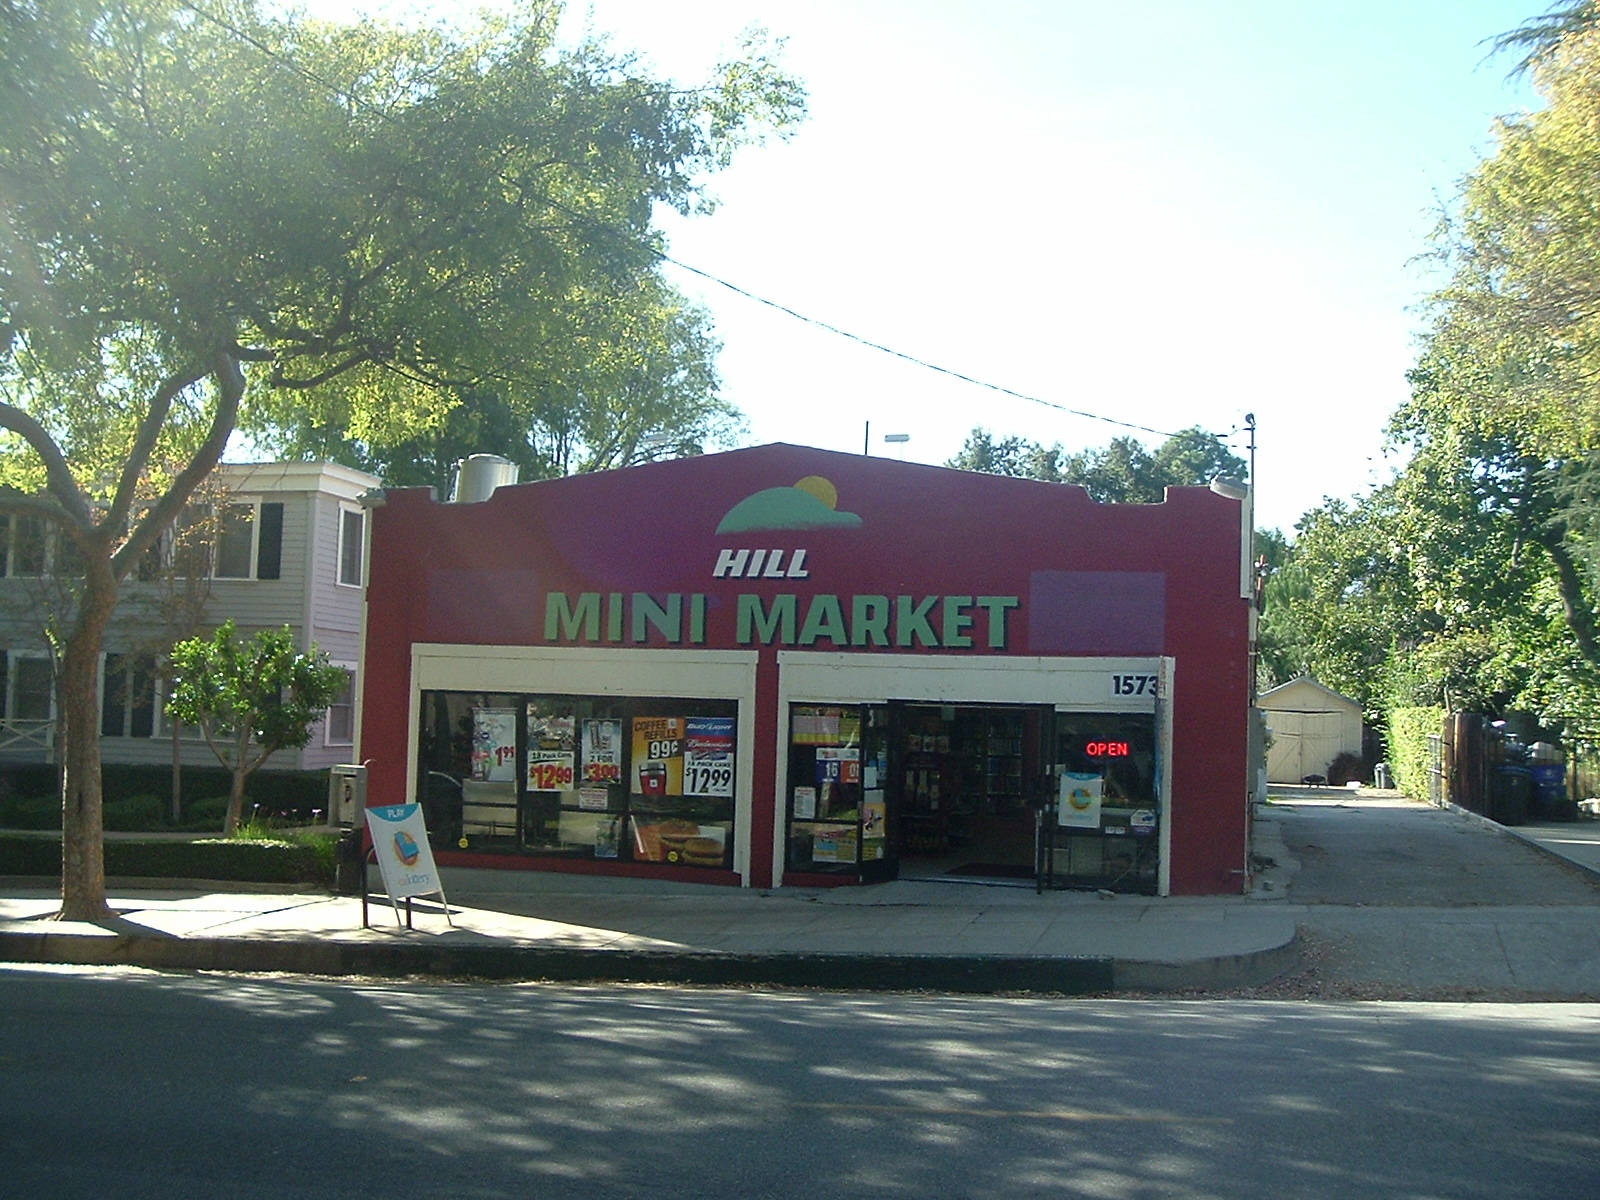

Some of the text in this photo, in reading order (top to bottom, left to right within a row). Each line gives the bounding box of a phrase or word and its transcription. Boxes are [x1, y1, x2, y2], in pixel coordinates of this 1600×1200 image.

[713, 549, 809, 578] HILL
[544, 592, 1019, 648] MINI MARKET
[1113, 675, 1158, 695] 1573
[634, 720, 667, 732] COFFEE
[644, 729, 678, 740] REFILLS
[650, 740, 678, 759] 99¢
[1086, 742, 1129, 756] OPEN
